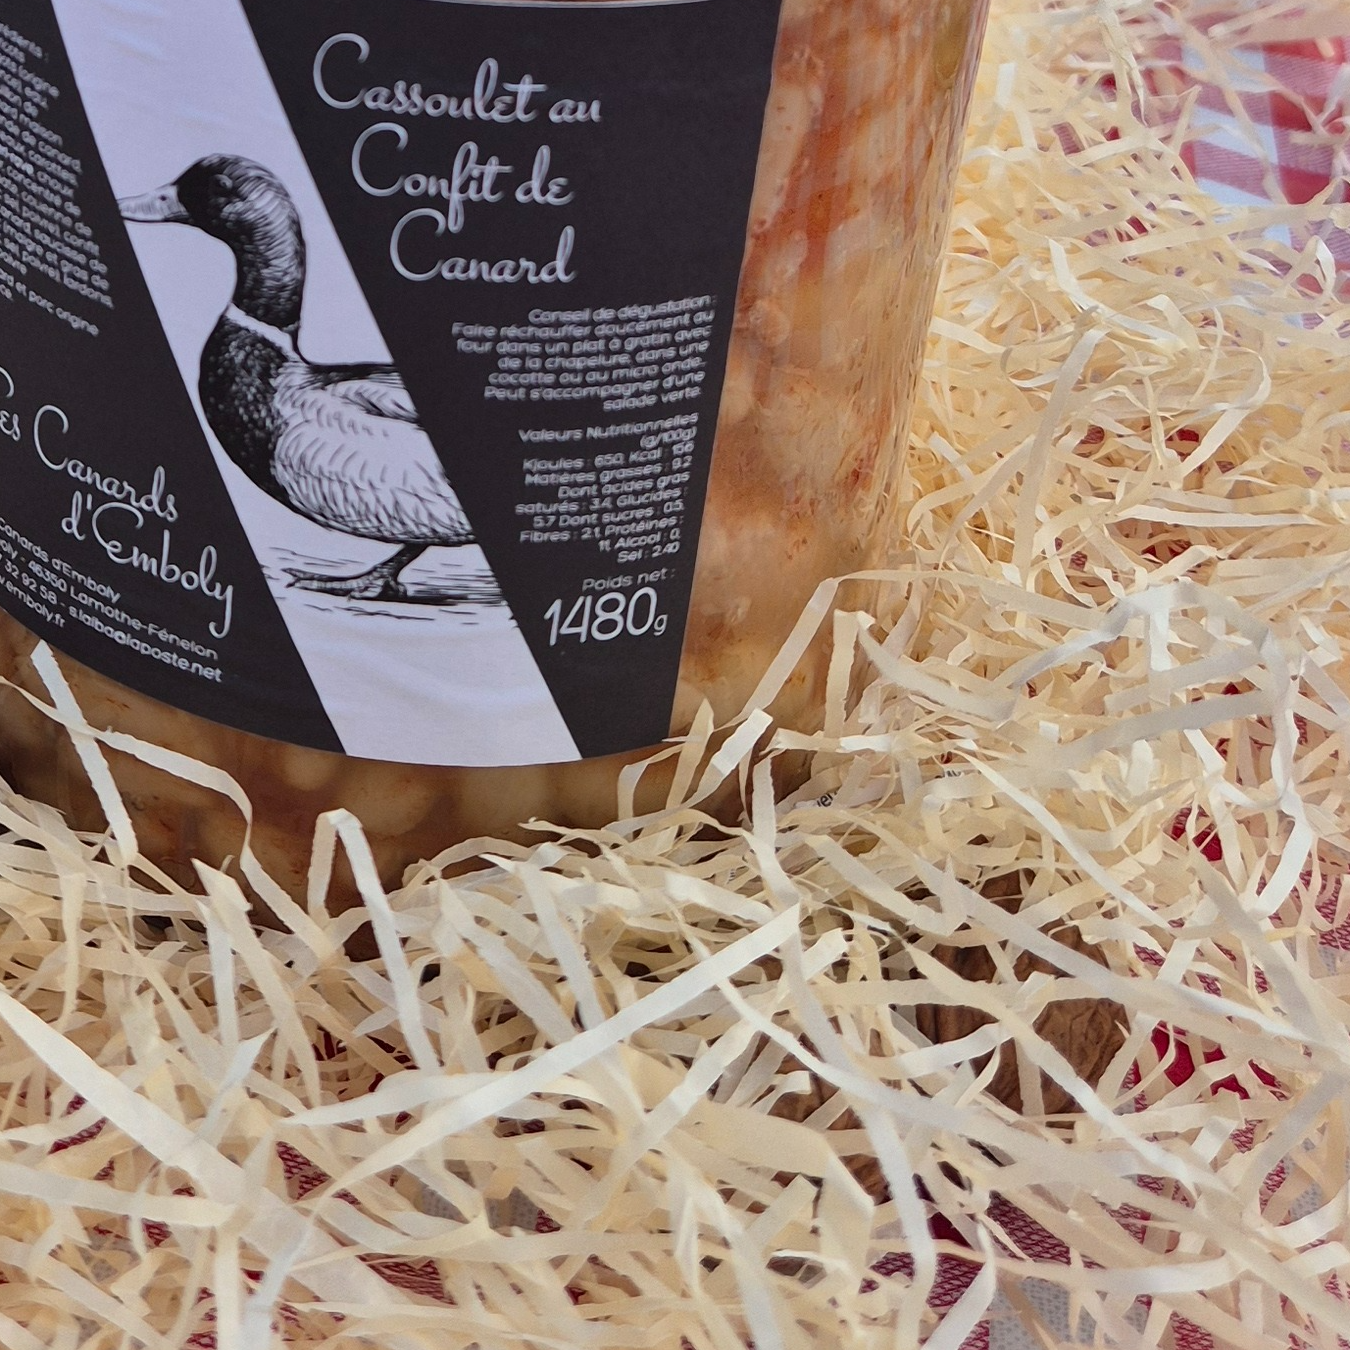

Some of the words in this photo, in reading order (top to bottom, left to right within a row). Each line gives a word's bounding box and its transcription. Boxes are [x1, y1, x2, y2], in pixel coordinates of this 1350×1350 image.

[312, 32, 548, 123] Cassoulet
[548, 99, 601, 123] au
[351, 122, 514, 233] Confit
[515, 145, 576, 206] de
[390, 207, 577, 284] Canard
[451, 322, 498, 339] Faire
[499, 323, 592, 340] réchauffer
[594, 312, 691, 337] doucement
[692, 309, 715, 325] au
[528, 307, 592, 325] Conseil
[592, 307, 617, 322] de
[616, 294, 712, 321] dégustation
[456, 337, 493, 354] four
[495, 340, 542, 355] dans
[544, 341, 570, 355] un
[571, 338, 606, 355] plat
[608, 336, 622, 352] à
[623, 332, 672, 352] gratin
[674, 325, 713, 343] avec
[497, 356, 523, 370] de
[524, 356, 543, 371] la
[635, 346, 677, 364] dans
[678, 340, 710, 357] une
[483, 385, 527, 401] Peut
[529, 379, 660, 401] s'accompagner
[662, 370, 706, 389] d'une
[488, 371, 557, 386] cocotte
[558, 372, 583, 385] ou
[585, 370, 610, 384] au
[611, 364, 660, 381] micro
[603, 393, 658, 411] salade
[518, 428, 583, 443] Valeurs
[585, 412, 699, 439] Nutritionnelles
[639, 426, 698, 450] (g/100g)
[33, 404, 179, 522] Canards
[522, 457, 585, 473] Kjoules
[628, 446, 663, 463] Kcal
[524, 471, 597, 486] Matières
[599, 462, 663, 484] grasses
[557, 483, 599, 499] Dont
[601, 478, 654, 495] acides
[656, 471, 691, 490] gras
[515, 499, 580, 515] saturés
[616, 487, 682, 508] Glucides
[519, 530, 571, 543] Fibres
[604, 515, 678, 537] Protéines
[533, 515, 557, 529] 5.7
[558, 512, 599, 527] Dont
[601, 506, 655, 524] sucres
[613, 531, 662, 550] Alcool
[617, 548, 643, 563] Sel
[61, 490, 233, 638] d'Emboly
[582, 574, 633, 591] Poids
[636, 567, 668, 585] net
[4, 558, 20, 580] 32
[21, 572, 38, 593] 92
[39, 584, 58, 605] 58
[51, 558, 121, 604] d'Emboly
[28, 560, 68, 593] 46350
[70, 585, 218, 660] Lamothe-Fénelon
